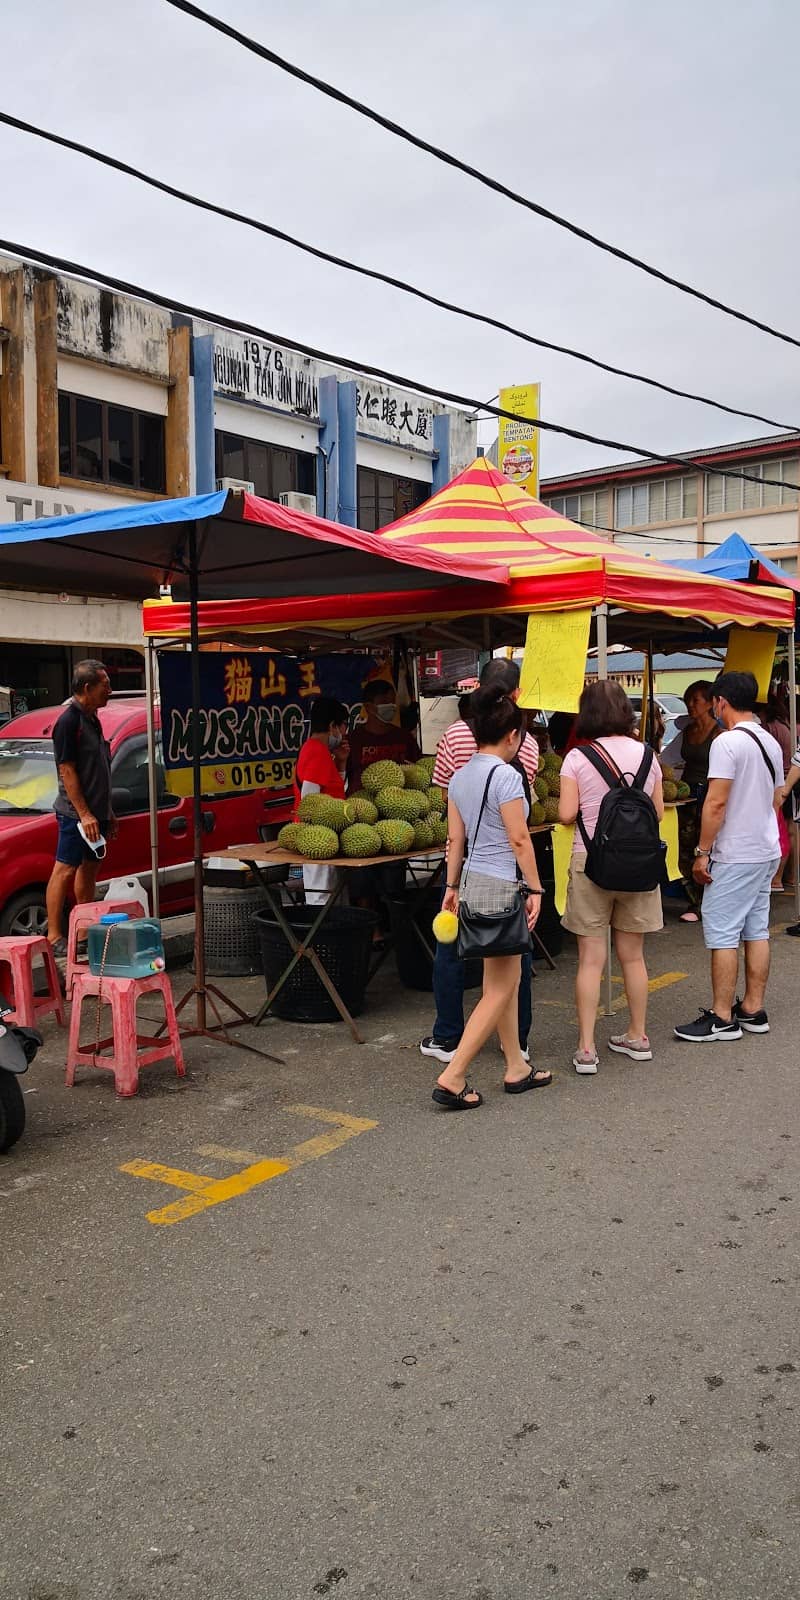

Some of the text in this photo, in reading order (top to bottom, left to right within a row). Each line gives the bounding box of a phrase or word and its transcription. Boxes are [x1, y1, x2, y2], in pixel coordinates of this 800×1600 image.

[243, 340, 283, 371] 1976
[255, 363, 274, 400] TAN
[169, 703, 306, 762] MUSANG
[231, 760, 296, 786] 016-98
